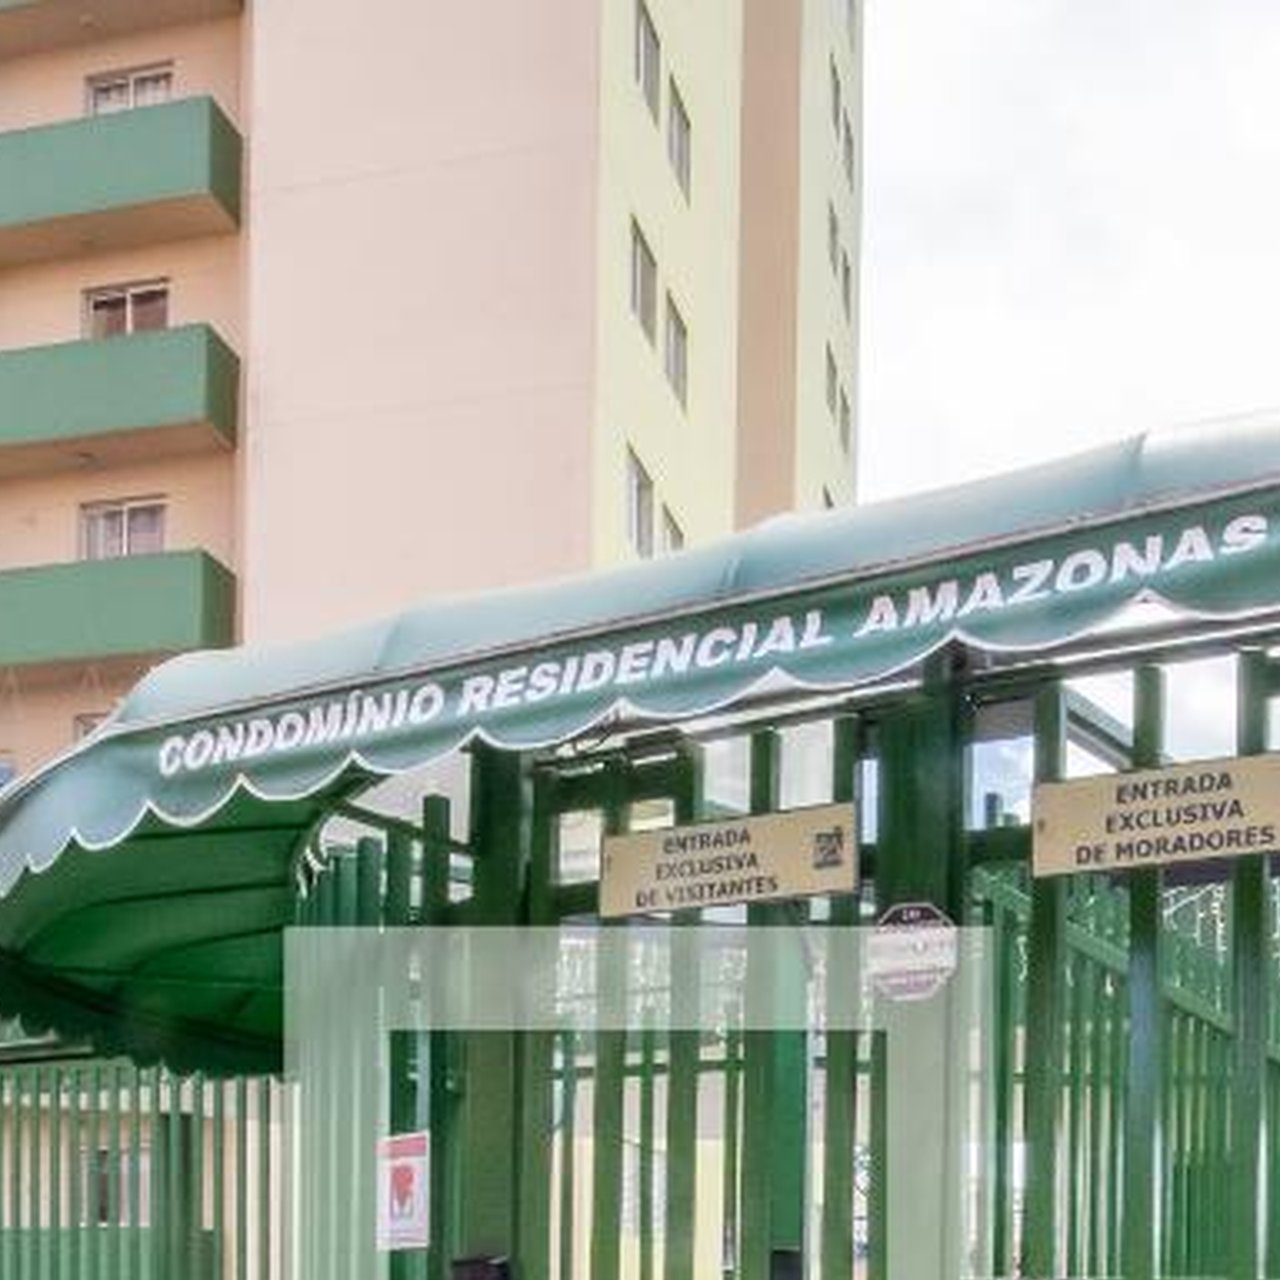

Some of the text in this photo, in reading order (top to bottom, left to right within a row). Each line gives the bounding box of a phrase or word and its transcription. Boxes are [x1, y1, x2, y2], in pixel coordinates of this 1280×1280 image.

[157, 515, 1268, 776] CONDOMÍNIO RESIDENCIAL AMAZONAS
[1115, 772, 1233, 805] ENTRADA
[1105, 799, 1246, 834] EXCLUSIVA
[662, 828, 752, 855] ENTRADA
[1075, 825, 1276, 866] DE MORADORES
[655, 852, 759, 882] EXCLUSIVA
[634, 876, 780, 908] DE VISITANTES
